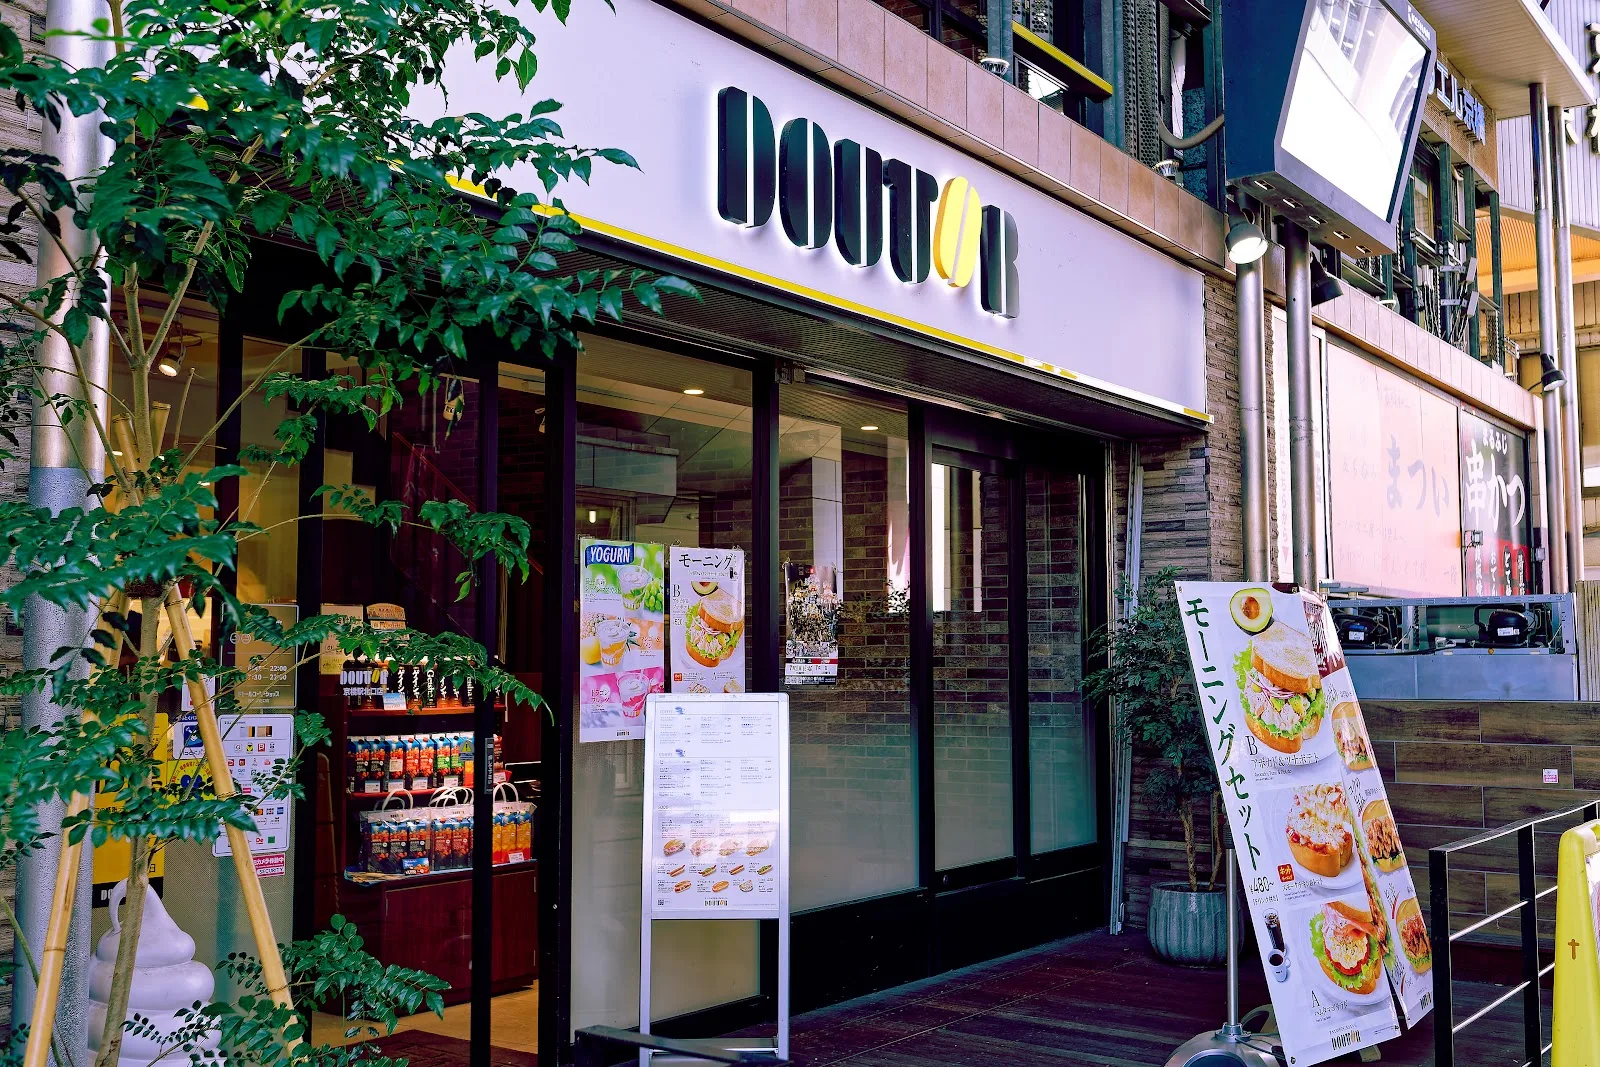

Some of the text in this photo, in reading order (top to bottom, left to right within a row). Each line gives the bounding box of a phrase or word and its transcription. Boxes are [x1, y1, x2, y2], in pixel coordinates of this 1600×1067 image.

[717, 86, 1020, 318] DOUTOR
[1482, 427, 1508, 455] まるふじ
[1465, 438, 1526, 533] 串かつ
[590, 546, 630, 563] YOGURN
[679, 553, 733, 571] モーニング
[672, 584, 681, 598] B
[340, 669, 389, 685] DOUTOR
[1185, 597, 1261, 871] モーニングセット
[1245, 735, 1258, 756] B
[1311, 990, 1321, 1009] A
